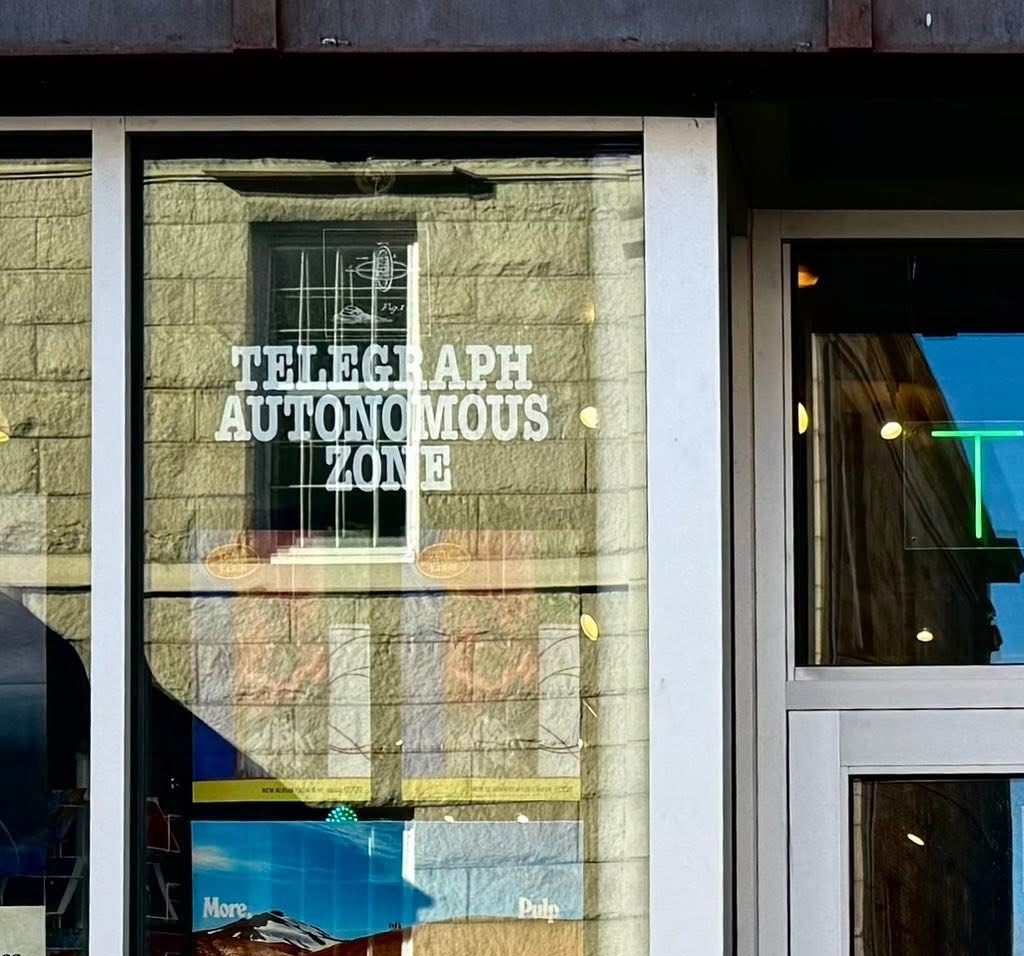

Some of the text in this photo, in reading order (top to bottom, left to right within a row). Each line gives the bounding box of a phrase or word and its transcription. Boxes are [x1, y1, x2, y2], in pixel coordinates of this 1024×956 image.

[231, 344, 533, 391] TELEGRAPH
[214, 394, 549, 442] AUTONOMOUS
[325, 444, 451, 491] ZONE
[518, 897, 561, 923] Pulp
